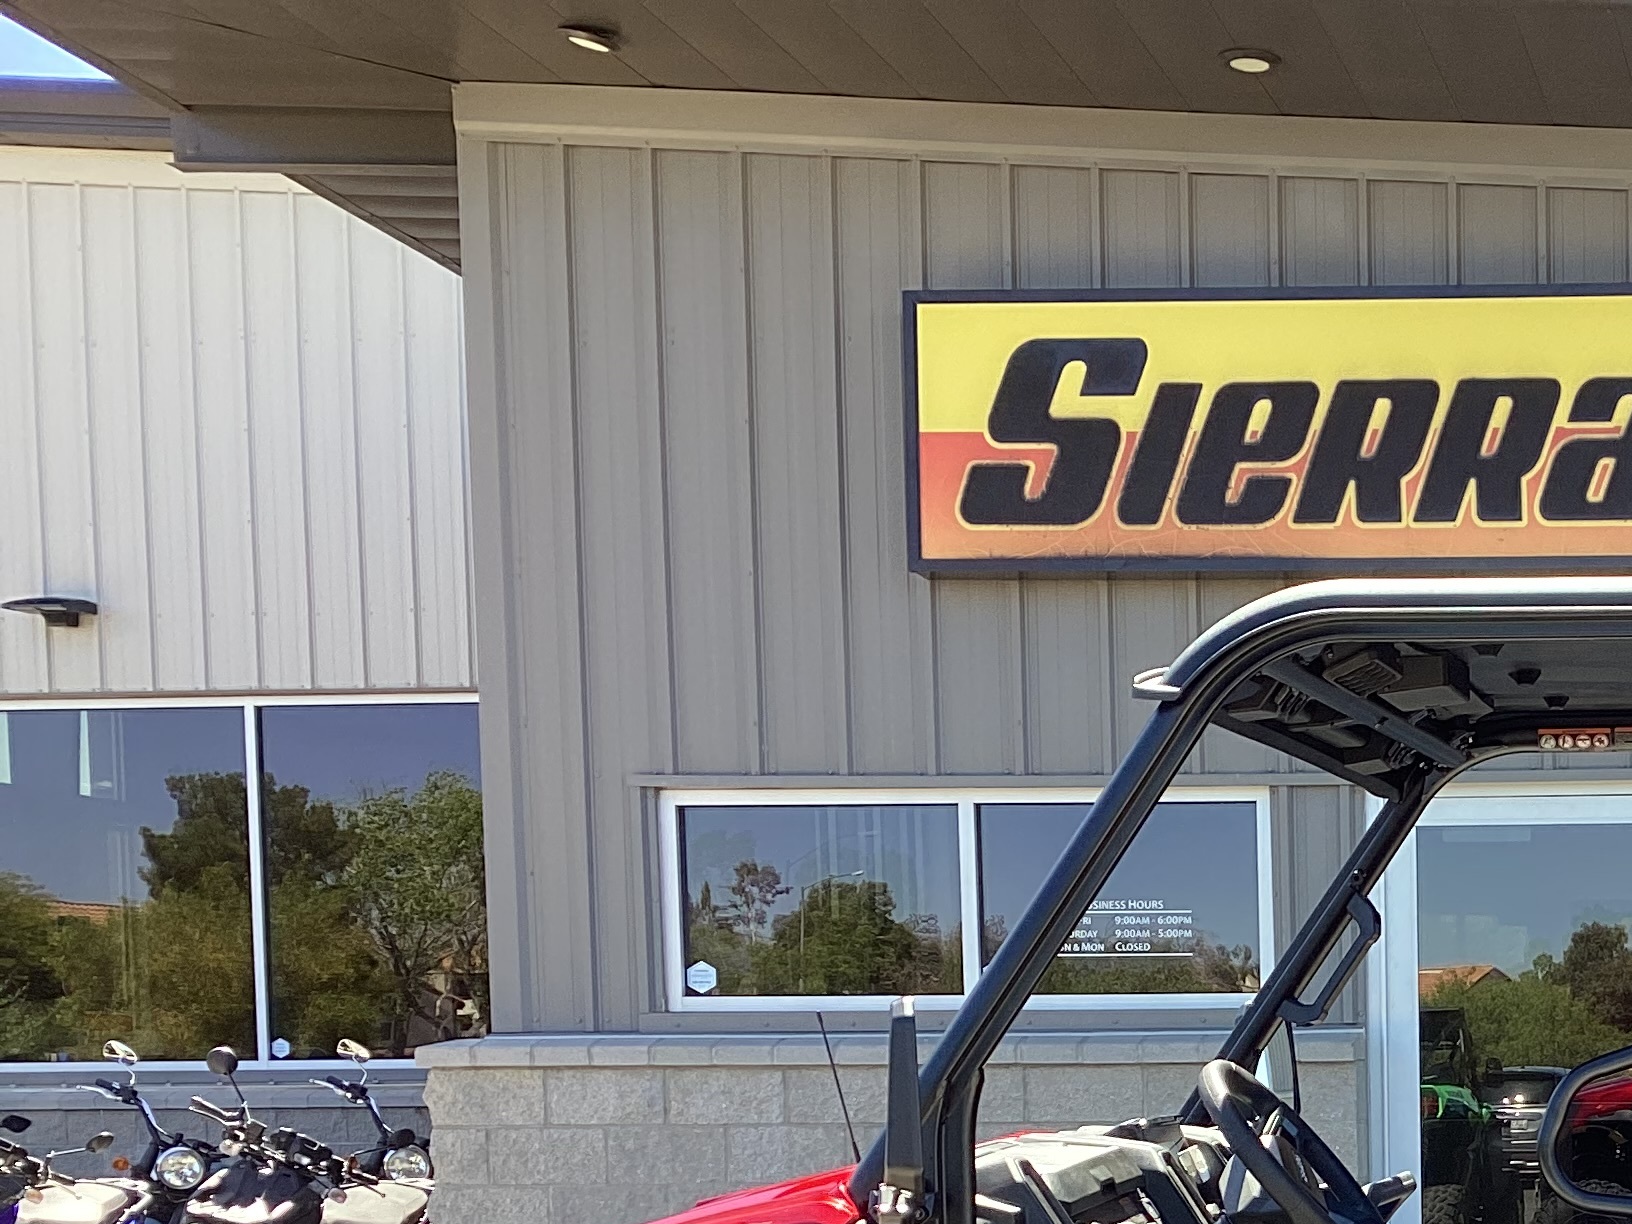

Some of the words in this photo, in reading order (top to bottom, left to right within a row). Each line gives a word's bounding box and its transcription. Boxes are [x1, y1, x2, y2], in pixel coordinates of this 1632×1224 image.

[1114, 916, 1150, 925] 9:00AM
[1157, 916, 1192, 925] 6:00PM
[1115, 929, 1151, 938] 9:00AM
[1158, 929, 1193, 938] 5:00PM
